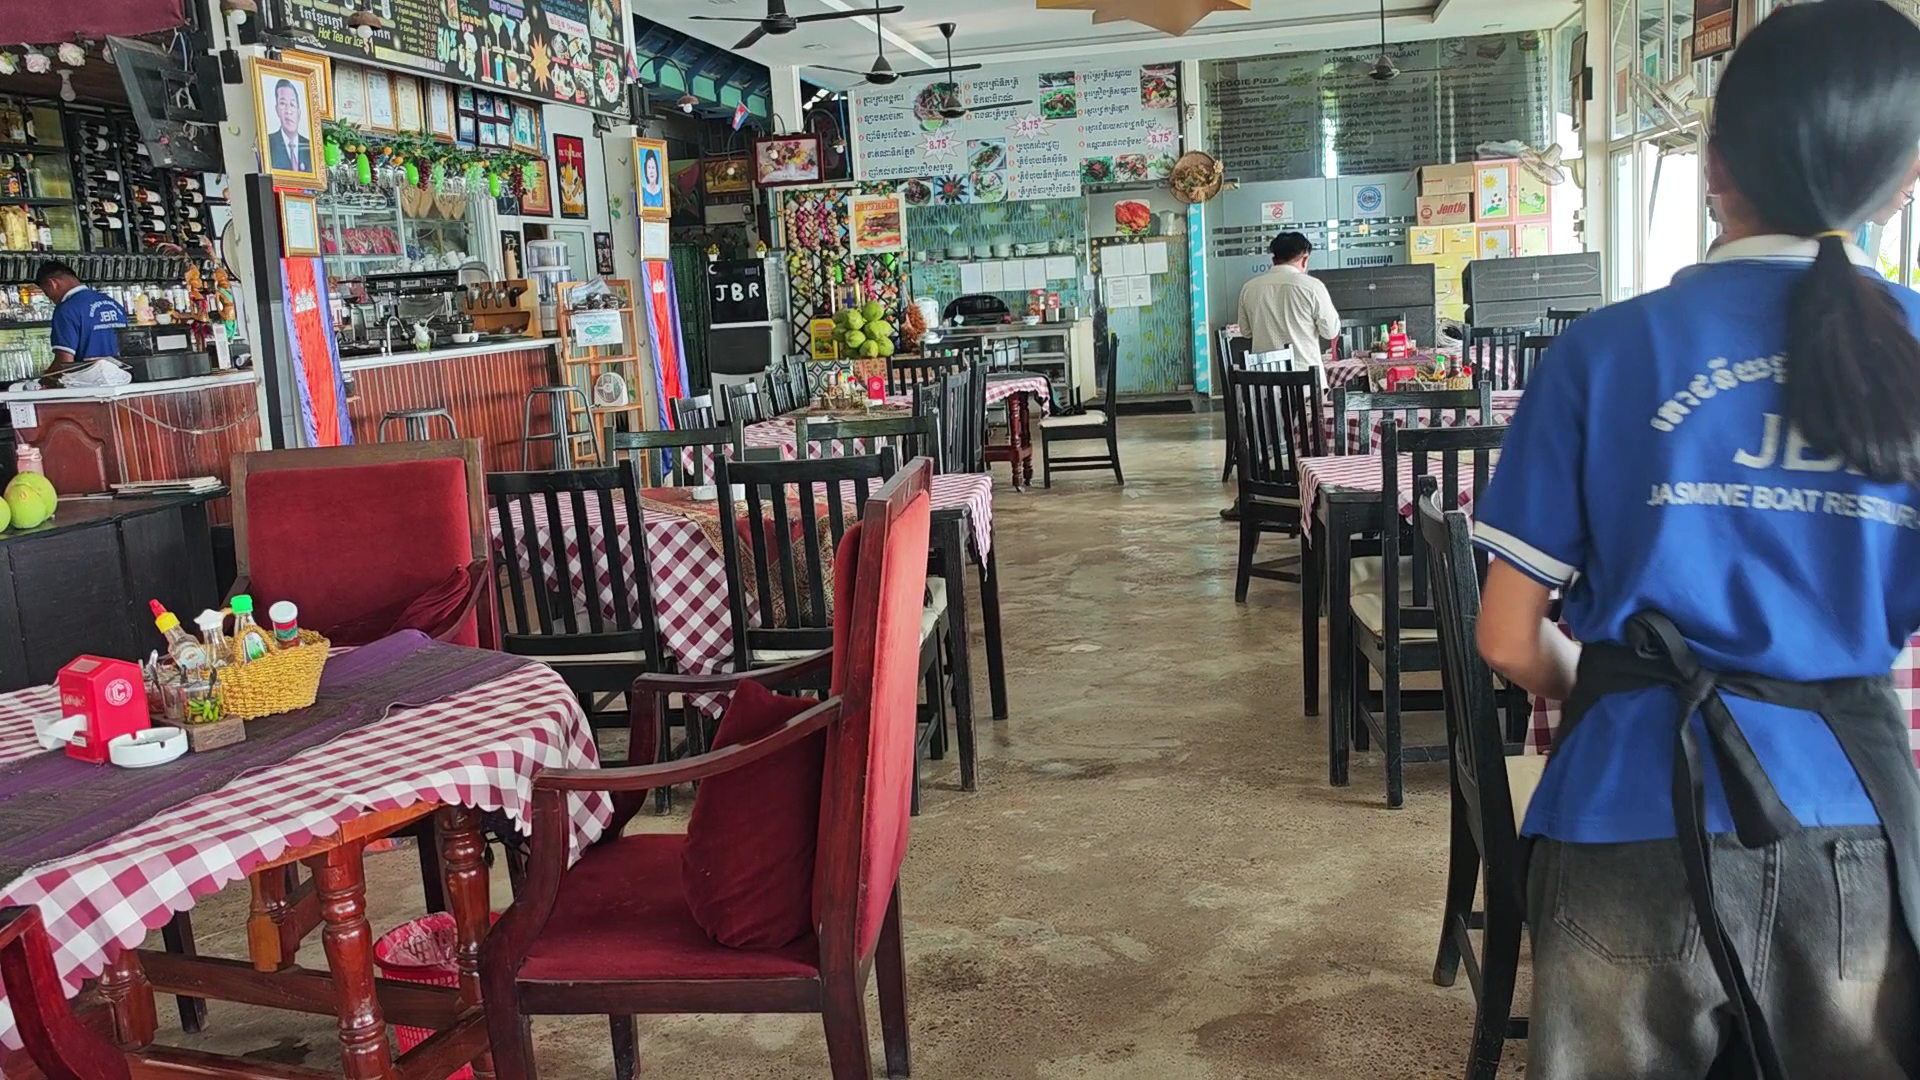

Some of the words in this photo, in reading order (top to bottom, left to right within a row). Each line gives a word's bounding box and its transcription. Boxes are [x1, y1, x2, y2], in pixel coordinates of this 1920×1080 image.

[318, 27, 331, 40] Hot
[332, 30, 344, 43] Tea
[345, 36, 352, 45] or
[353, 36, 364, 48] Ice
[1356, 54, 1374, 62] BOAT
[1261, 94, 1290, 103] Seafood
[1244, 145, 1261, 153] Crab
[715, 282, 760, 302] JBR
[100, 310, 118, 323] JBR
[1648, 482, 1750, 508] JASMINE
[1751, 486, 1823, 513] BOAT
